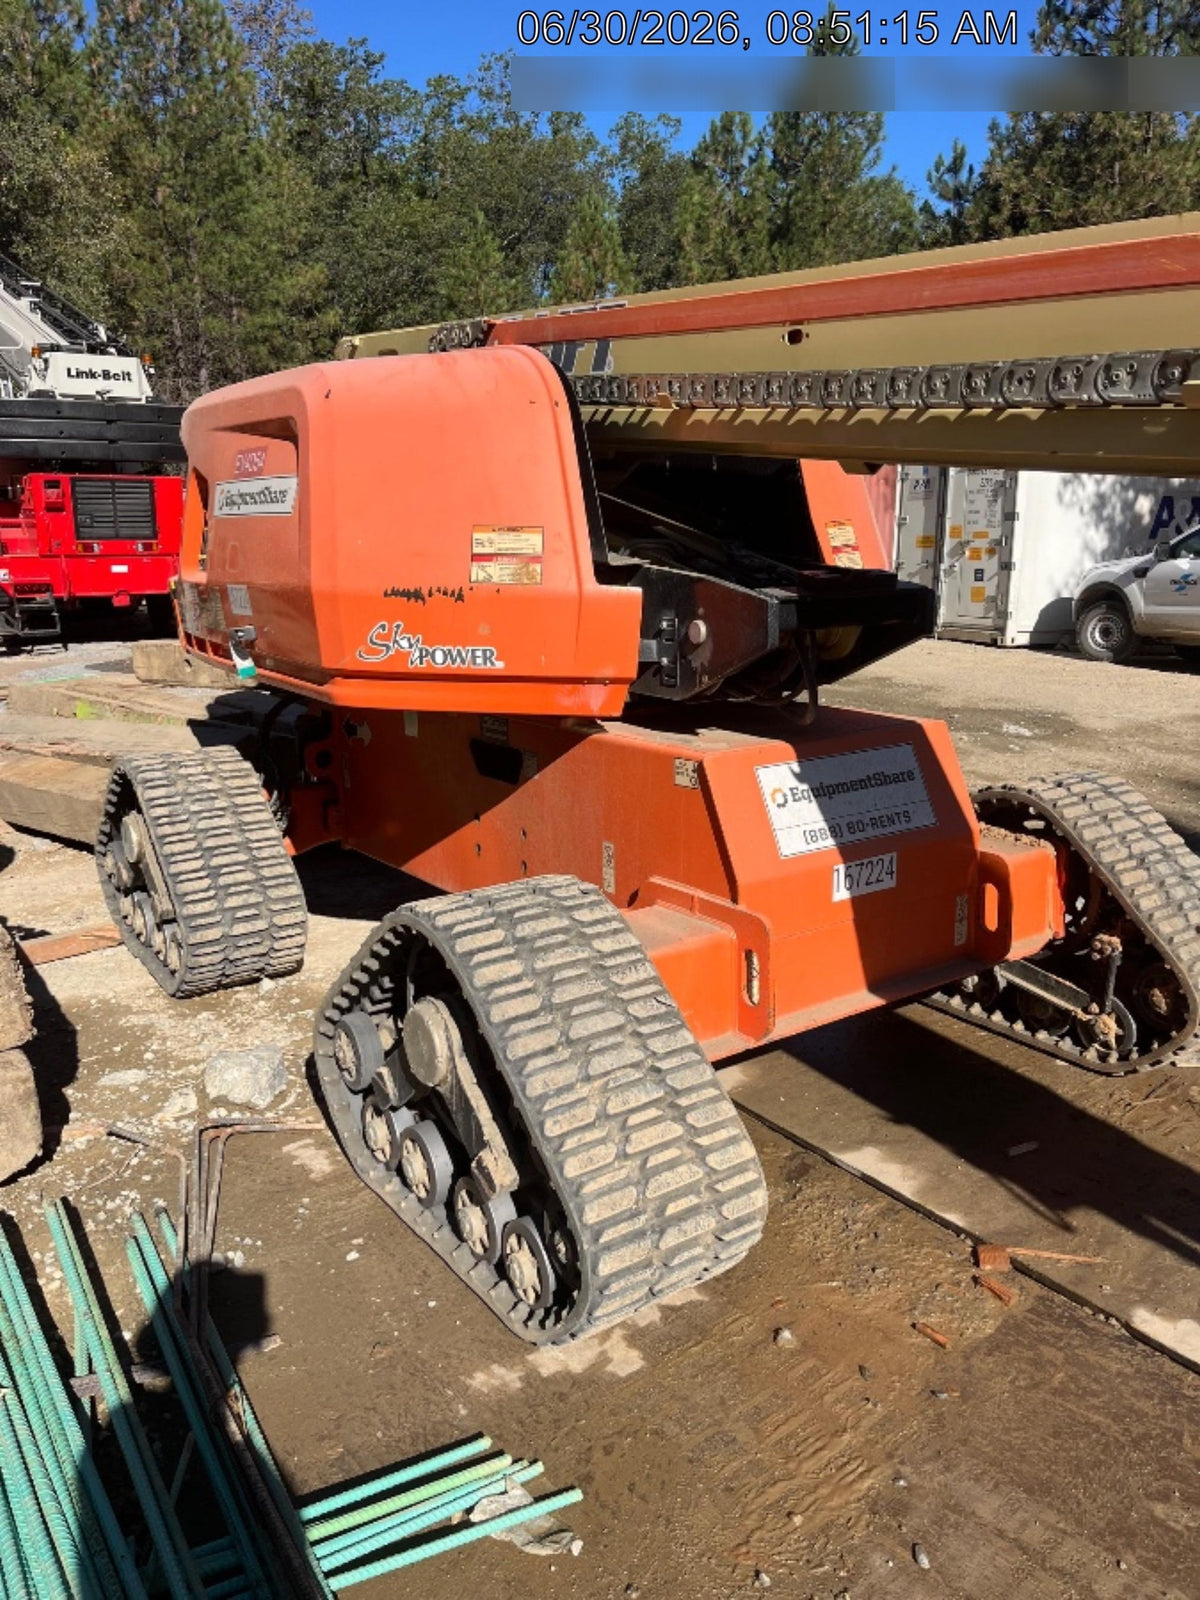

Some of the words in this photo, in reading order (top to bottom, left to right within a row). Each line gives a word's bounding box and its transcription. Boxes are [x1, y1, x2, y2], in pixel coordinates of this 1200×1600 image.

[67, 368, 132, 382] Link-Belt
[789, 769, 916, 803] EquipmentShare
[802, 823, 844, 845] (888)
[846, 810, 912, 835] 80-RENTS
[834, 856, 895, 893] 167224
